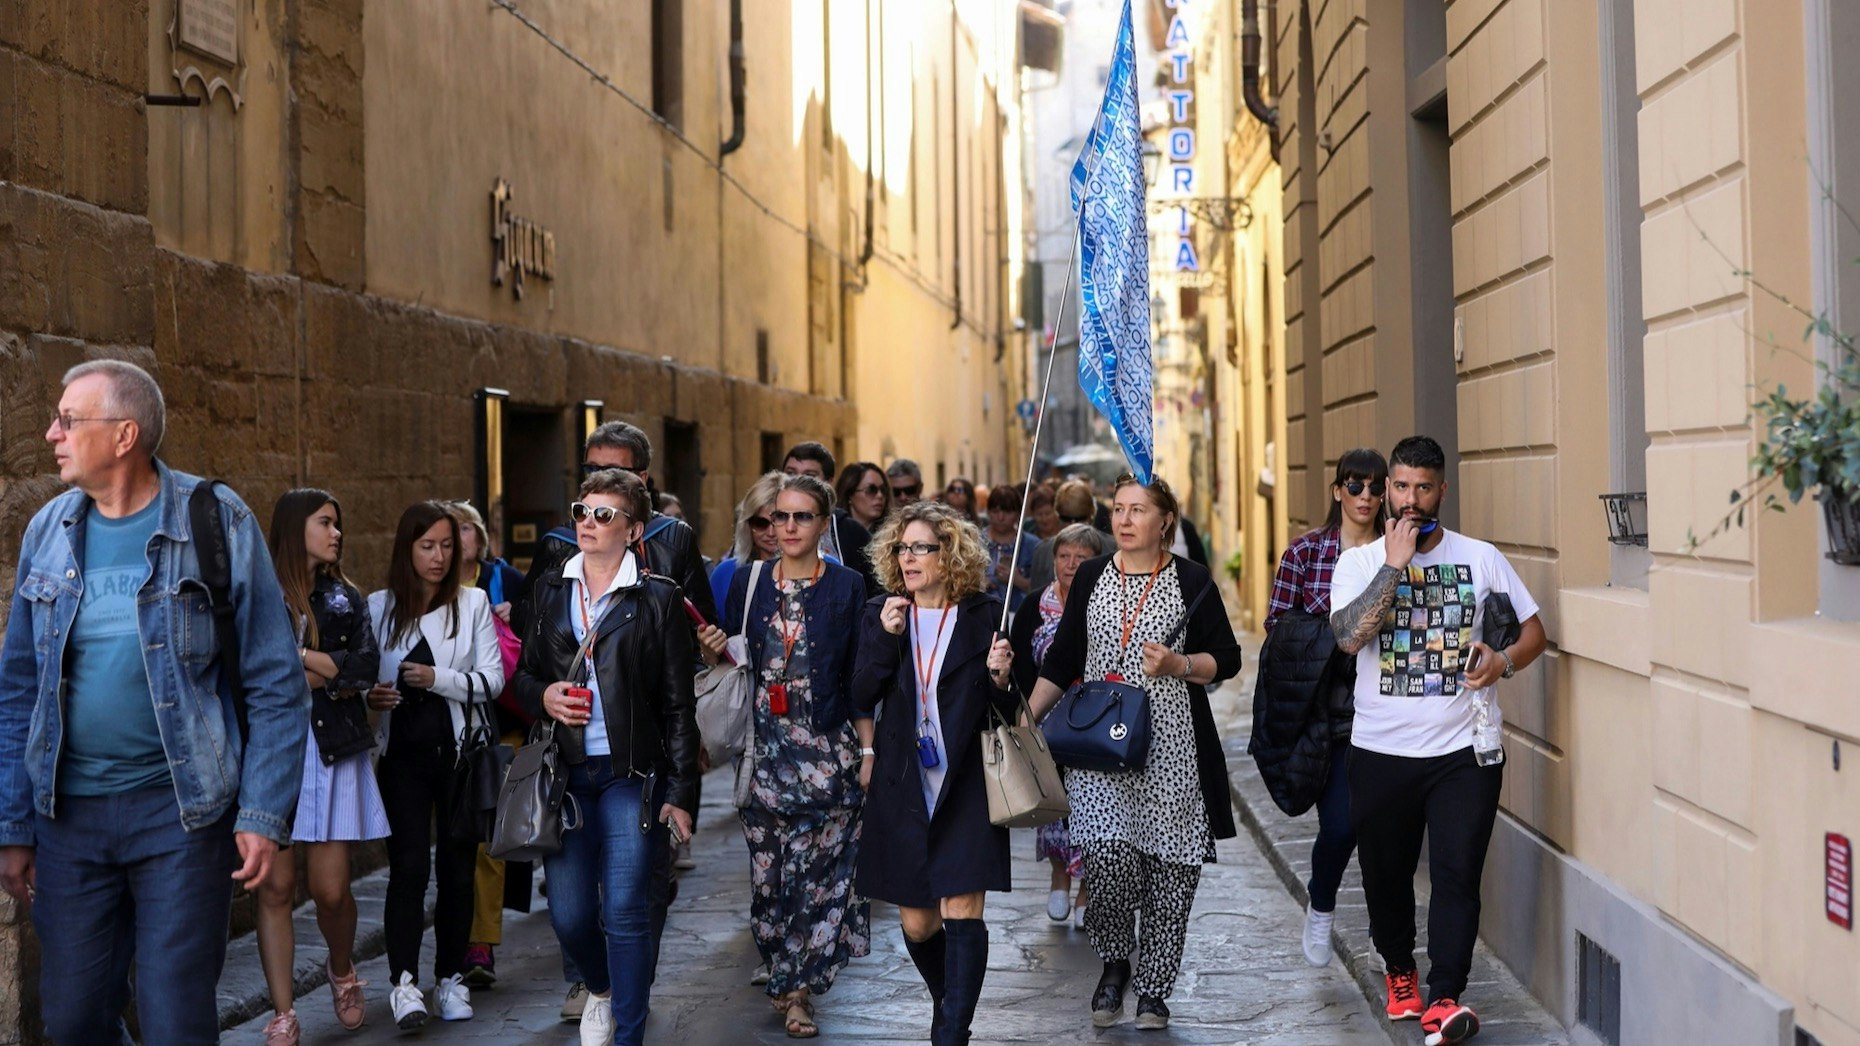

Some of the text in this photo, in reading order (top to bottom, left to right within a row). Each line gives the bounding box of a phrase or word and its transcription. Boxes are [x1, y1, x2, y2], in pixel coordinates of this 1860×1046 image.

[1167, 0, 1198, 269] ATTORIA
[1410, 677, 1423, 685] SAN
[1409, 685, 1423, 693] FRAN
